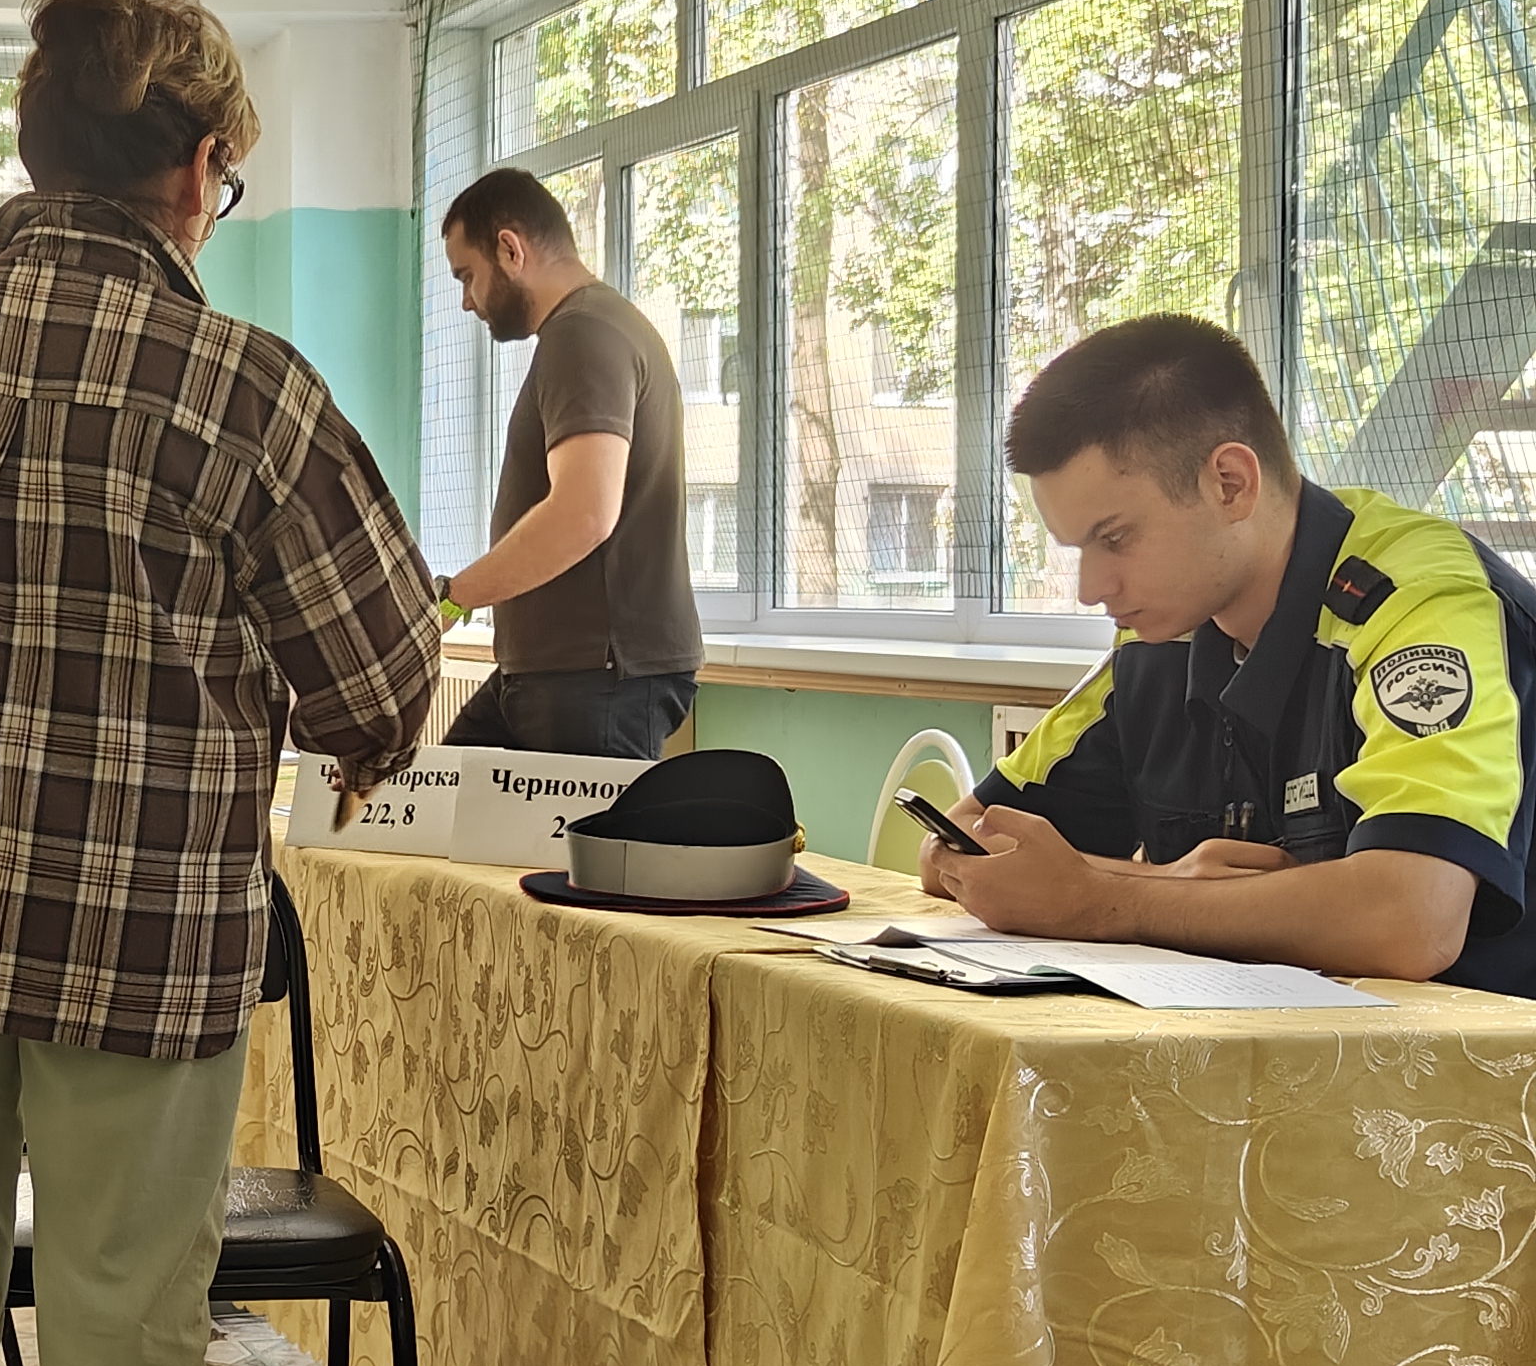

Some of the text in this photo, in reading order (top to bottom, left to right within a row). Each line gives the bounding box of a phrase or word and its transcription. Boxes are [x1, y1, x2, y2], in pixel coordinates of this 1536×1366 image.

[1376, 648, 1460, 679] ПОЛИЦИЯ
[1386, 662, 1458, 693] РОССИЯ
[1416, 718, 1451, 736] МВД
[320, 764, 460, 792] Чорска
[402, 803, 416, 825] 8
